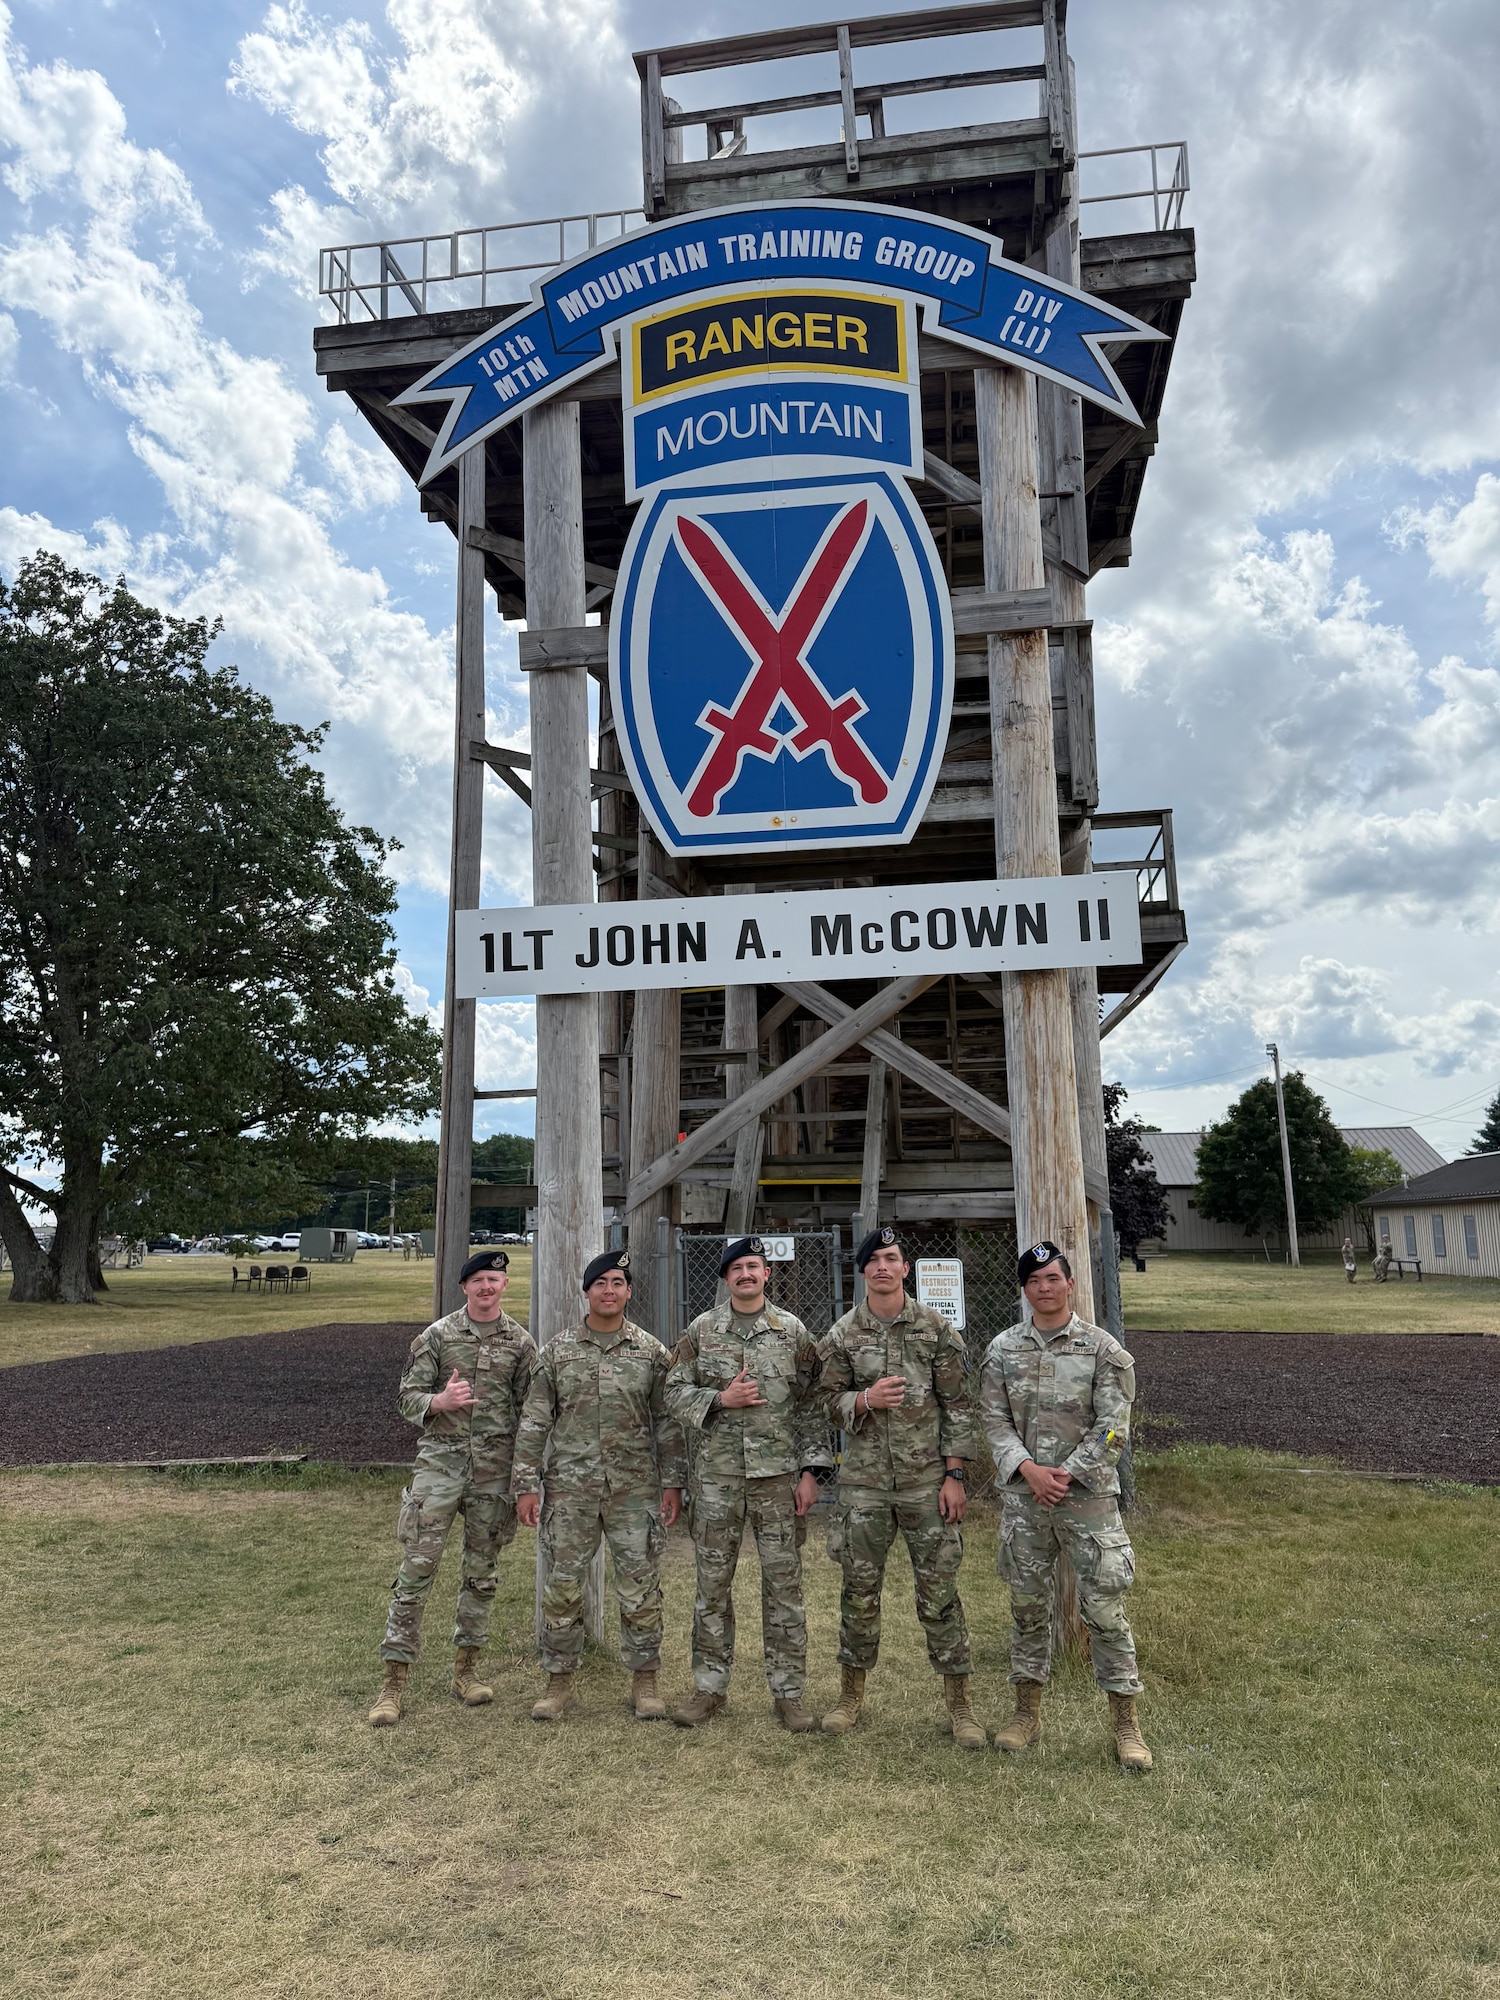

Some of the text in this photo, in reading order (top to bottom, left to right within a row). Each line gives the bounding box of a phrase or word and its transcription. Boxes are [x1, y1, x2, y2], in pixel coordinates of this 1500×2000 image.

[556, 229, 976, 324] MOUNTAIN TRAINING GROUP
[1014, 289, 1063, 324] DIV
[477, 333, 536, 379] 10th
[665, 311, 869, 372] RANGER
[1000, 315, 1053, 355] (LI)
[492, 355, 550, 403] MTN
[655, 399, 884, 462] MOUNTAIN
[479, 898, 1111, 973] 1LT JOHN A. McCOWN II
[921, 1278, 959, 1287] RESTRICTED
[928, 1288, 952, 1297] ACCESS
